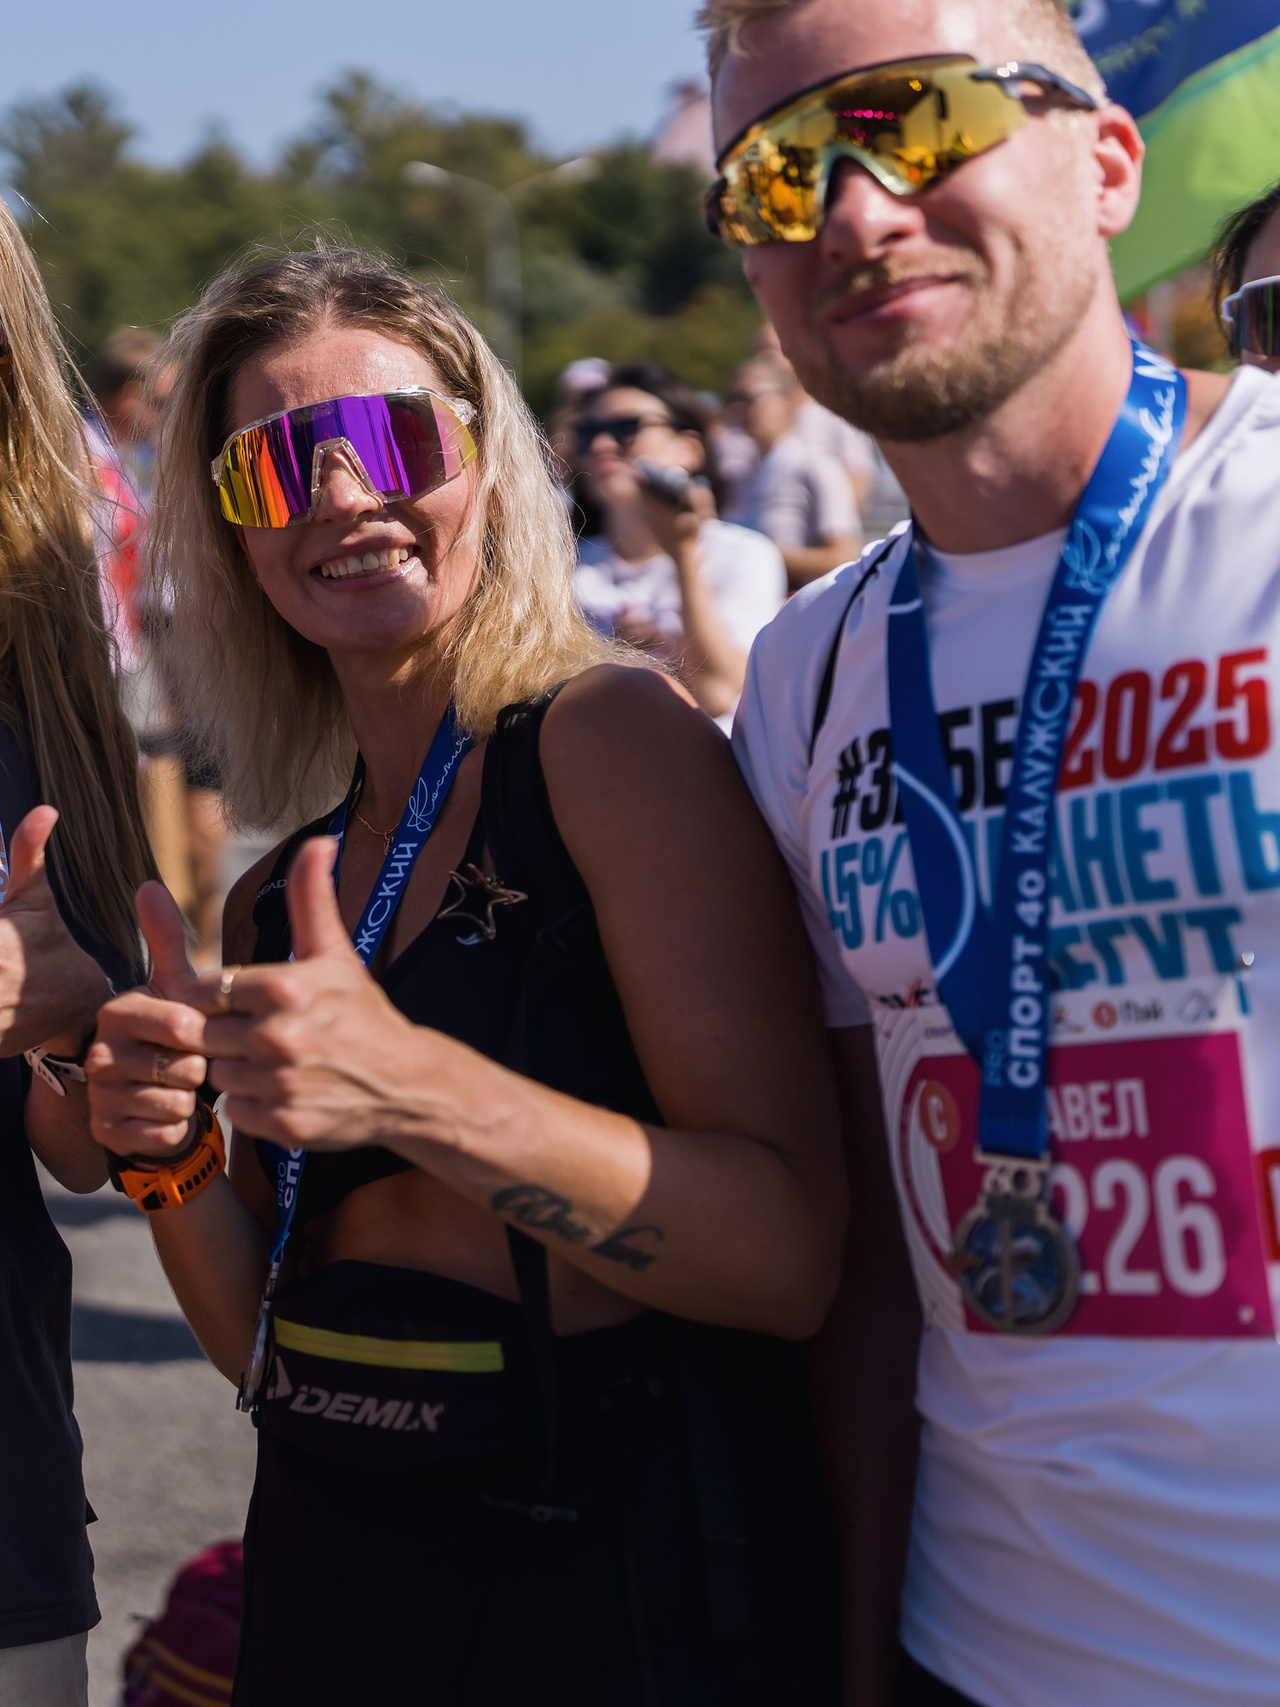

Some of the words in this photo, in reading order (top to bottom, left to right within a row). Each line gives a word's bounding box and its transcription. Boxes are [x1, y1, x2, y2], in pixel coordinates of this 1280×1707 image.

[1011, 604, 1093, 855] КАЛУЖСКИЙ
[1059, 646, 1272, 793] 2025
[354, 842, 419, 954] ЖСКИЙ
[1017, 870, 1046, 926] 40
[1049, 906, 1242, 990] ЕГУТ
[1007, 938, 1044, 1089] СПОРТ
[1046, 1078, 1149, 1144] АВЕЛ
[277, 1161, 287, 1208] PRO
[284, 1146, 303, 1210] СПО
[289, 1385, 445, 1433] DEMIX
